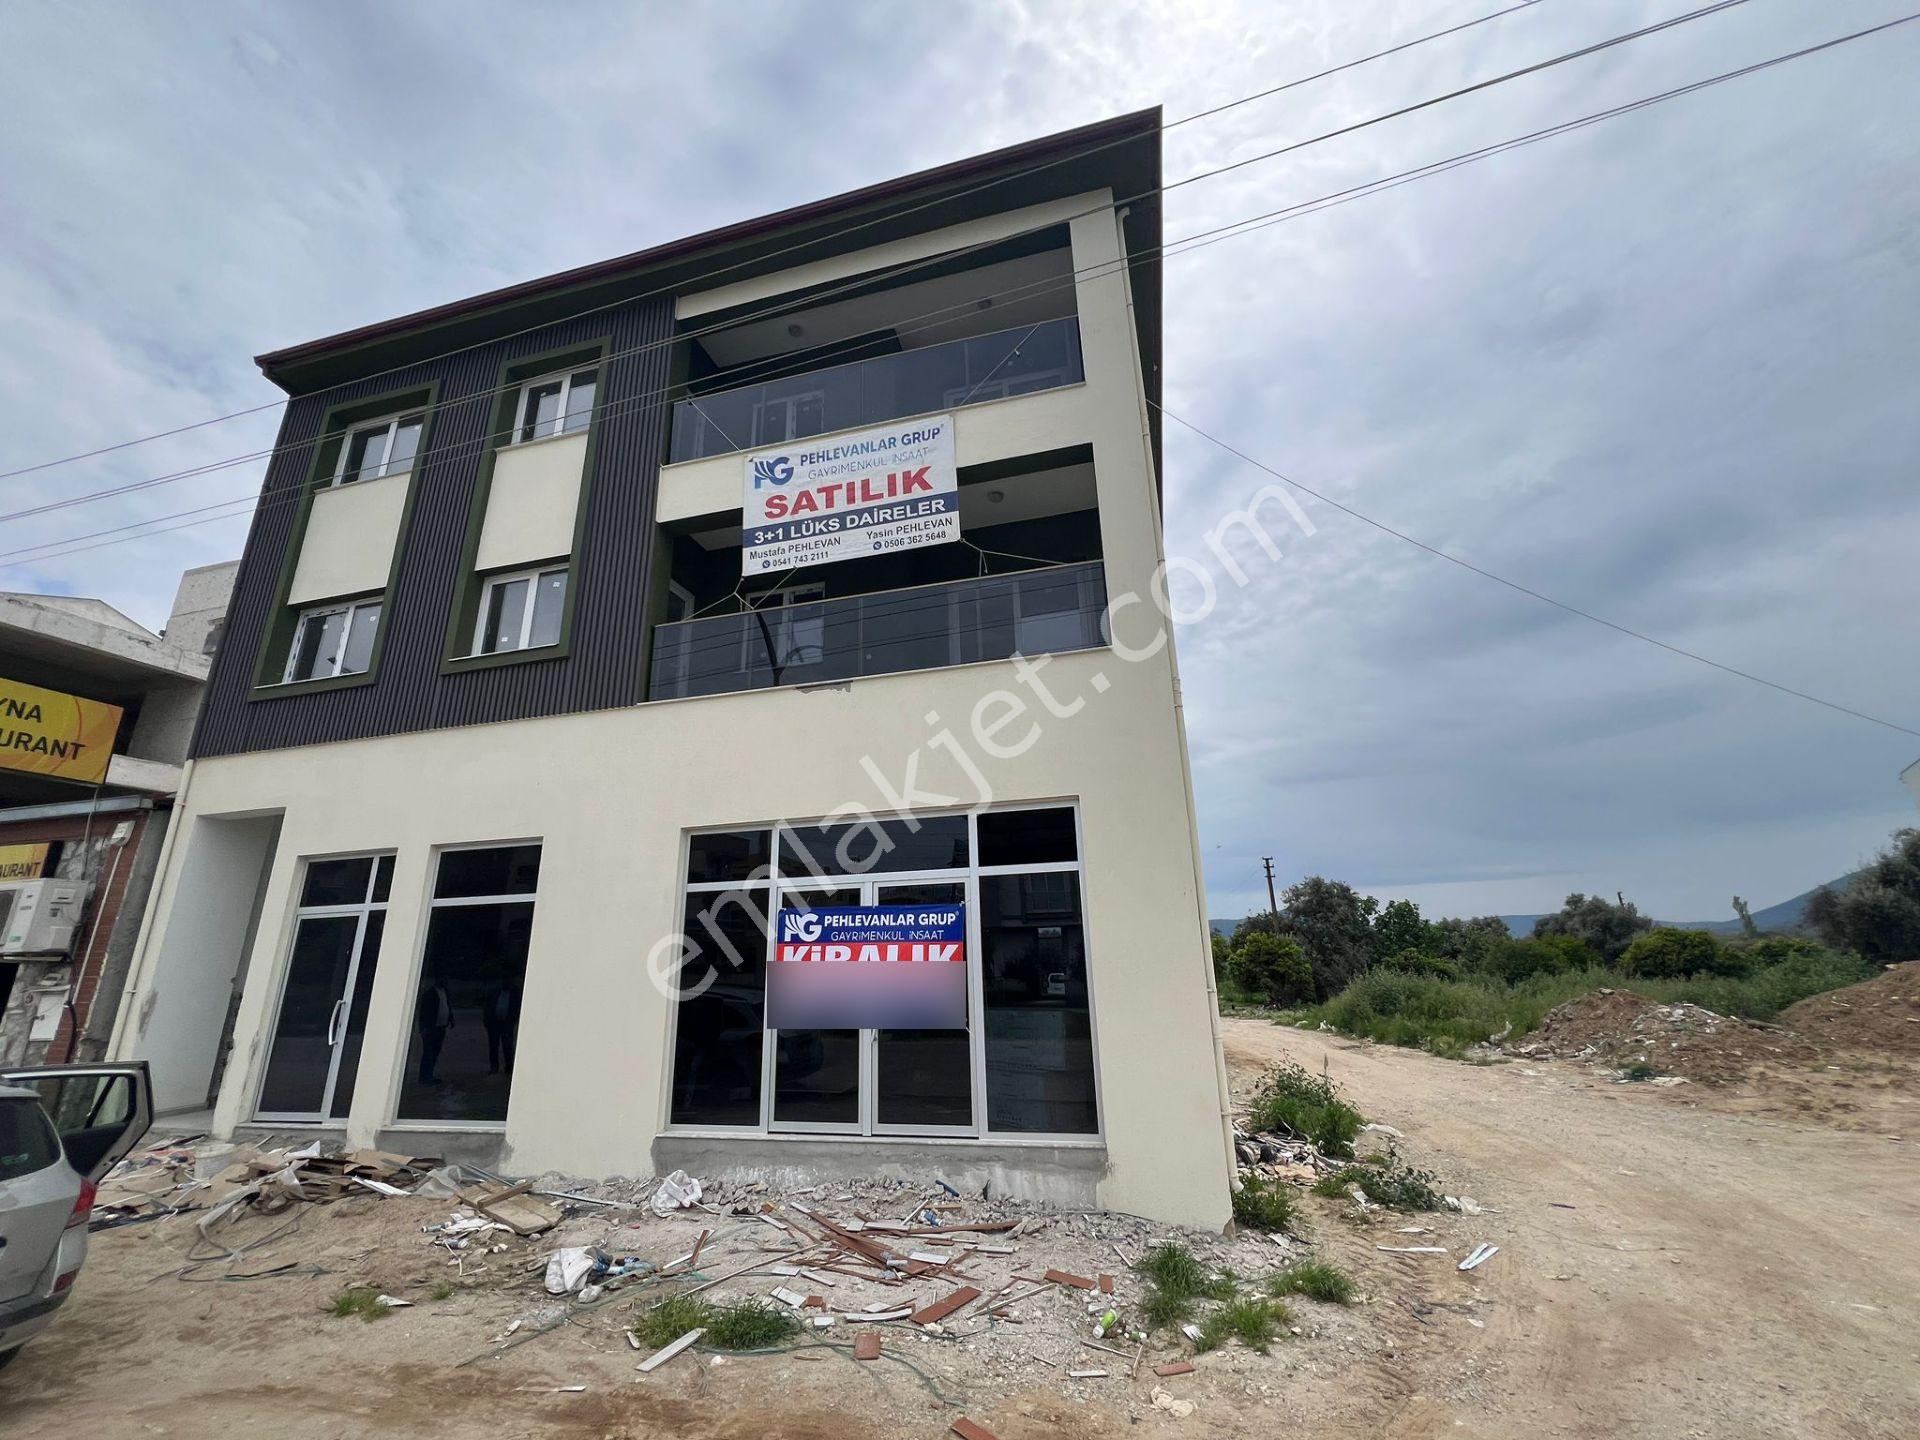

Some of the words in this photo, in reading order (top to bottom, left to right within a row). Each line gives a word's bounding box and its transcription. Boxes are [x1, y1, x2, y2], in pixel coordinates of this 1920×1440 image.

[799, 436, 897, 466] PEHLEVANLAR
[901, 427, 941, 446] GRUP
[764, 465, 933, 519] SATILIK
[754, 526, 783, 544] 3+1
[790, 516, 841, 538] LÜKS
[866, 528, 893, 540] Yasin
[896, 516, 953, 535] PEHLEVAN
[884, 537, 905, 549] 0506
[906, 534, 924, 546] 362
[925, 530, 947, 543] 5648
[749, 545, 786, 560] Mustafa
[788, 536, 842, 554] PEHLEVAN
[772, 556, 792, 567] 0541
[794, 553, 808, 564] 743
[809, 550, 829, 562] 2111
[0, 698, 42, 723] NA
[824, 914, 915, 927] PEHLEVANLAR
[918, 912, 957, 926] GRUP
